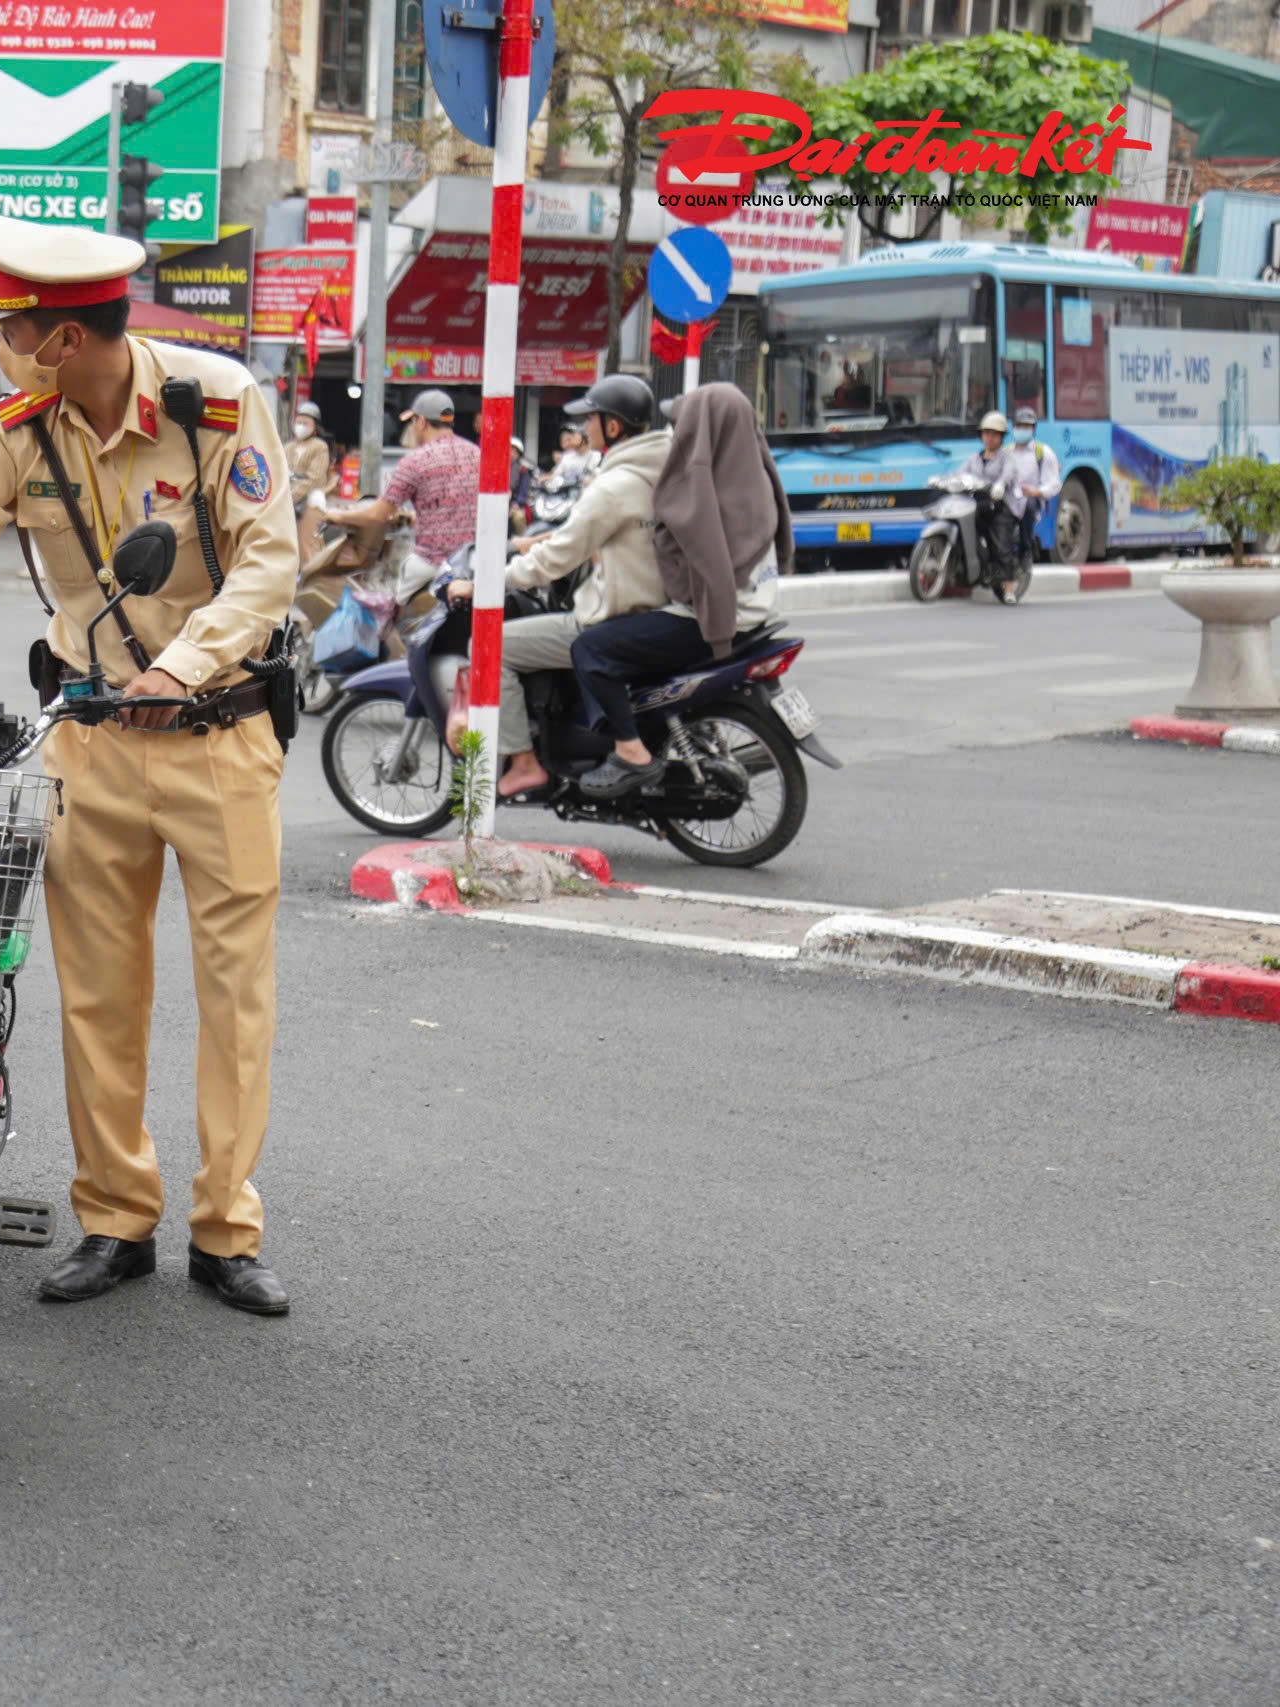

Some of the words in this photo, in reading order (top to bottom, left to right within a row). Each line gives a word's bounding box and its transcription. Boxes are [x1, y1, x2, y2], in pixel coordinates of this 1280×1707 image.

[45, 195, 77, 218] XE
[168, 191, 204, 222] SỐ
[173, 287, 231, 305] MOTOR
[1119, 345, 1150, 382] THÉP
[1154, 348, 1172, 383] MỸ
[1184, 356, 1210, 384] VMS
